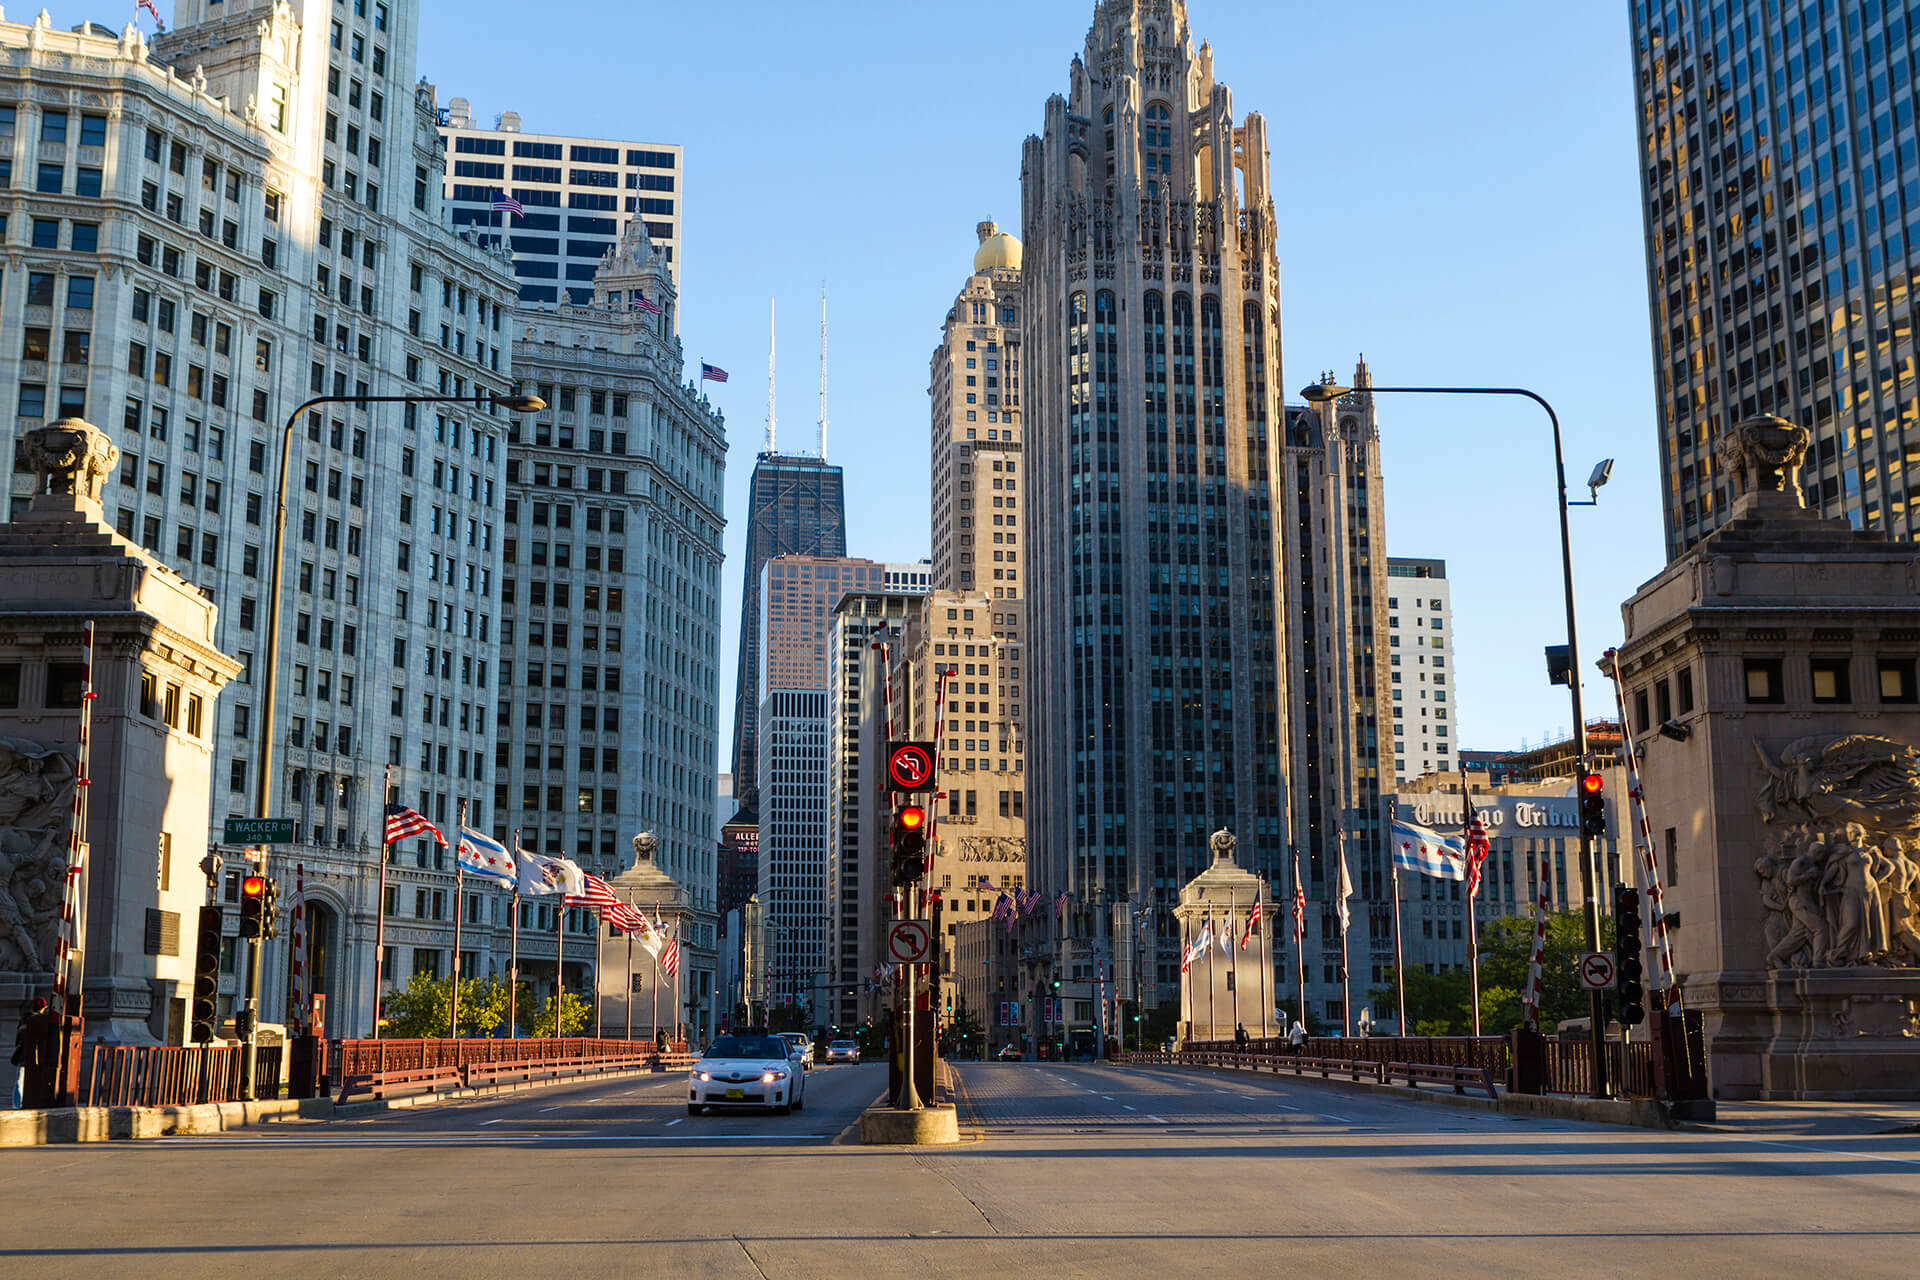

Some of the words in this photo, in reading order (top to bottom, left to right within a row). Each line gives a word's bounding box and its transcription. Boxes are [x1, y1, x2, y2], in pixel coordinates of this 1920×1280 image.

[1412, 801, 1504, 829] Chicgo
[227, 823, 233, 832] E
[235, 821, 279, 833] WACKER
[281, 823, 292, 832] DR
[246, 833, 262, 841] 340
[266, 833, 272, 841] N
